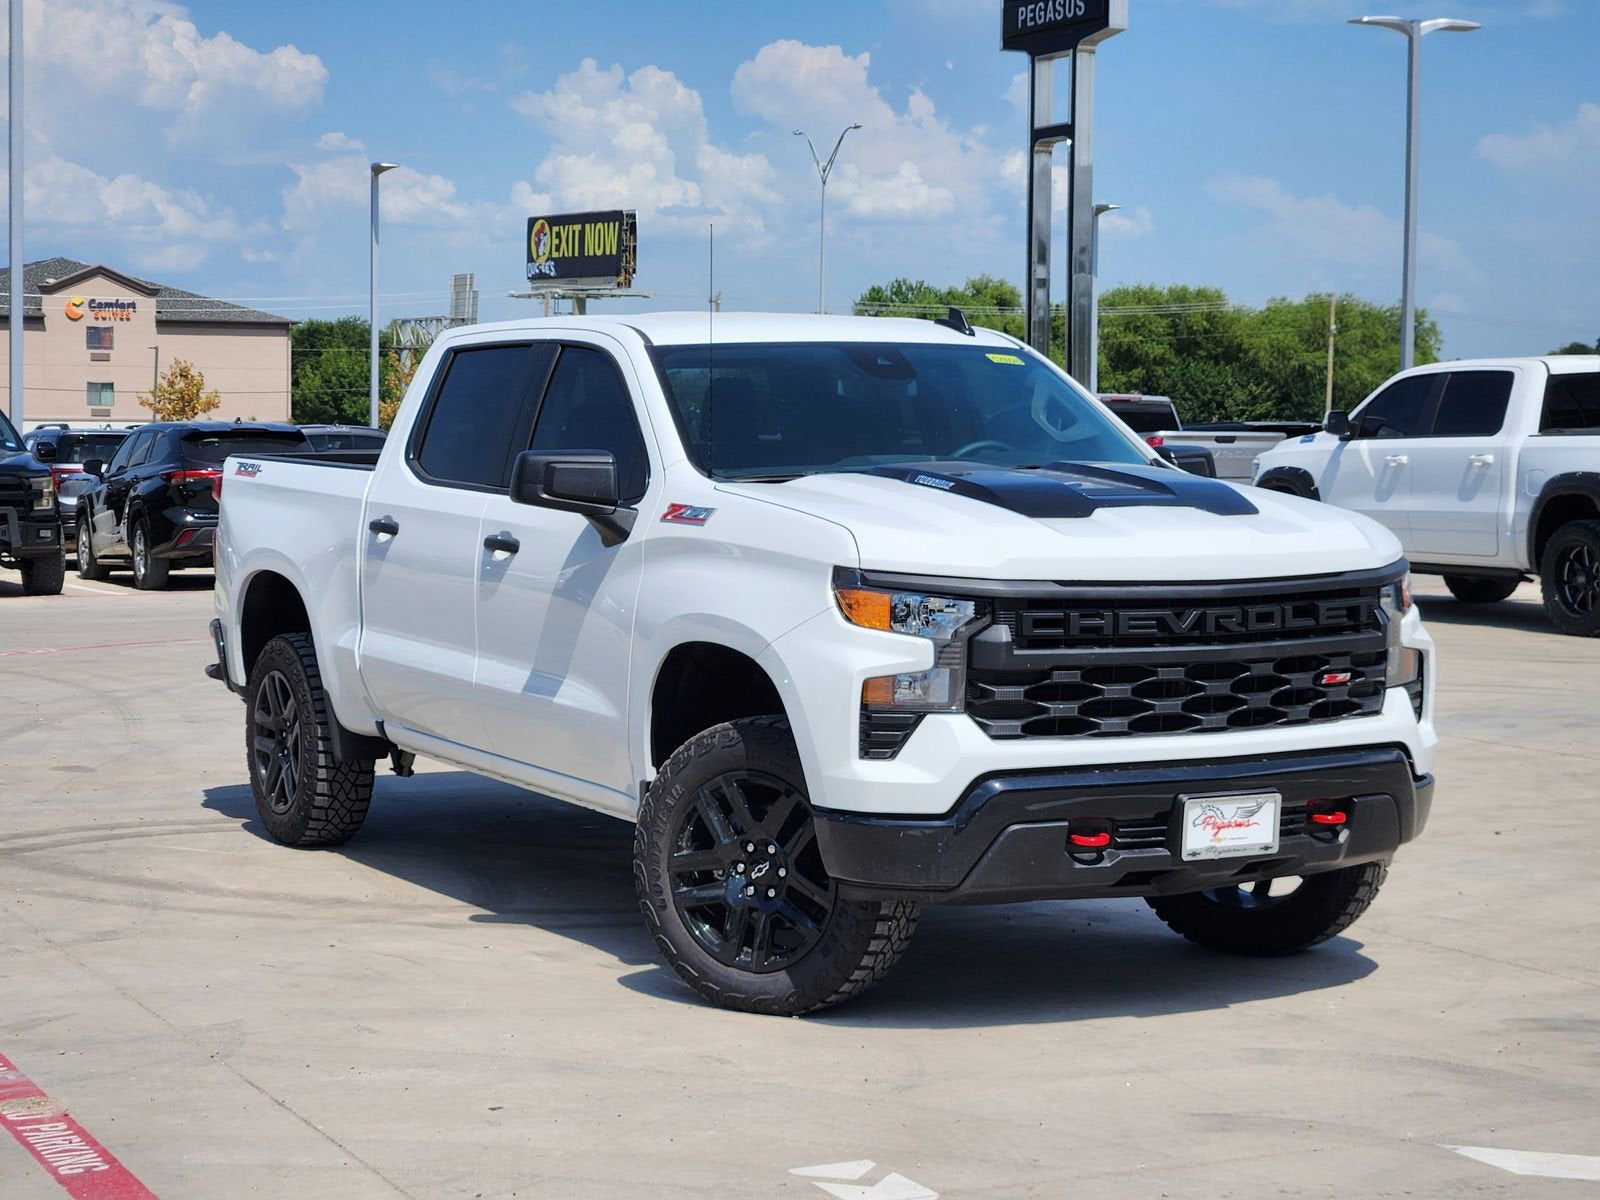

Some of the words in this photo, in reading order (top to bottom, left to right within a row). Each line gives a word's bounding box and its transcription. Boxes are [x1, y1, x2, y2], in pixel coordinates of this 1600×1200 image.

[1018, 0, 1085, 29] PEGASUS
[551, 224, 582, 258] EXIT
[584, 221, 619, 256] NOW
[88, 298, 137, 312] Comfort
[94, 310, 131, 322] SUITES
[1021, 597, 1380, 638] CHEVROLET
[16, 1122, 110, 1175] PARKING
